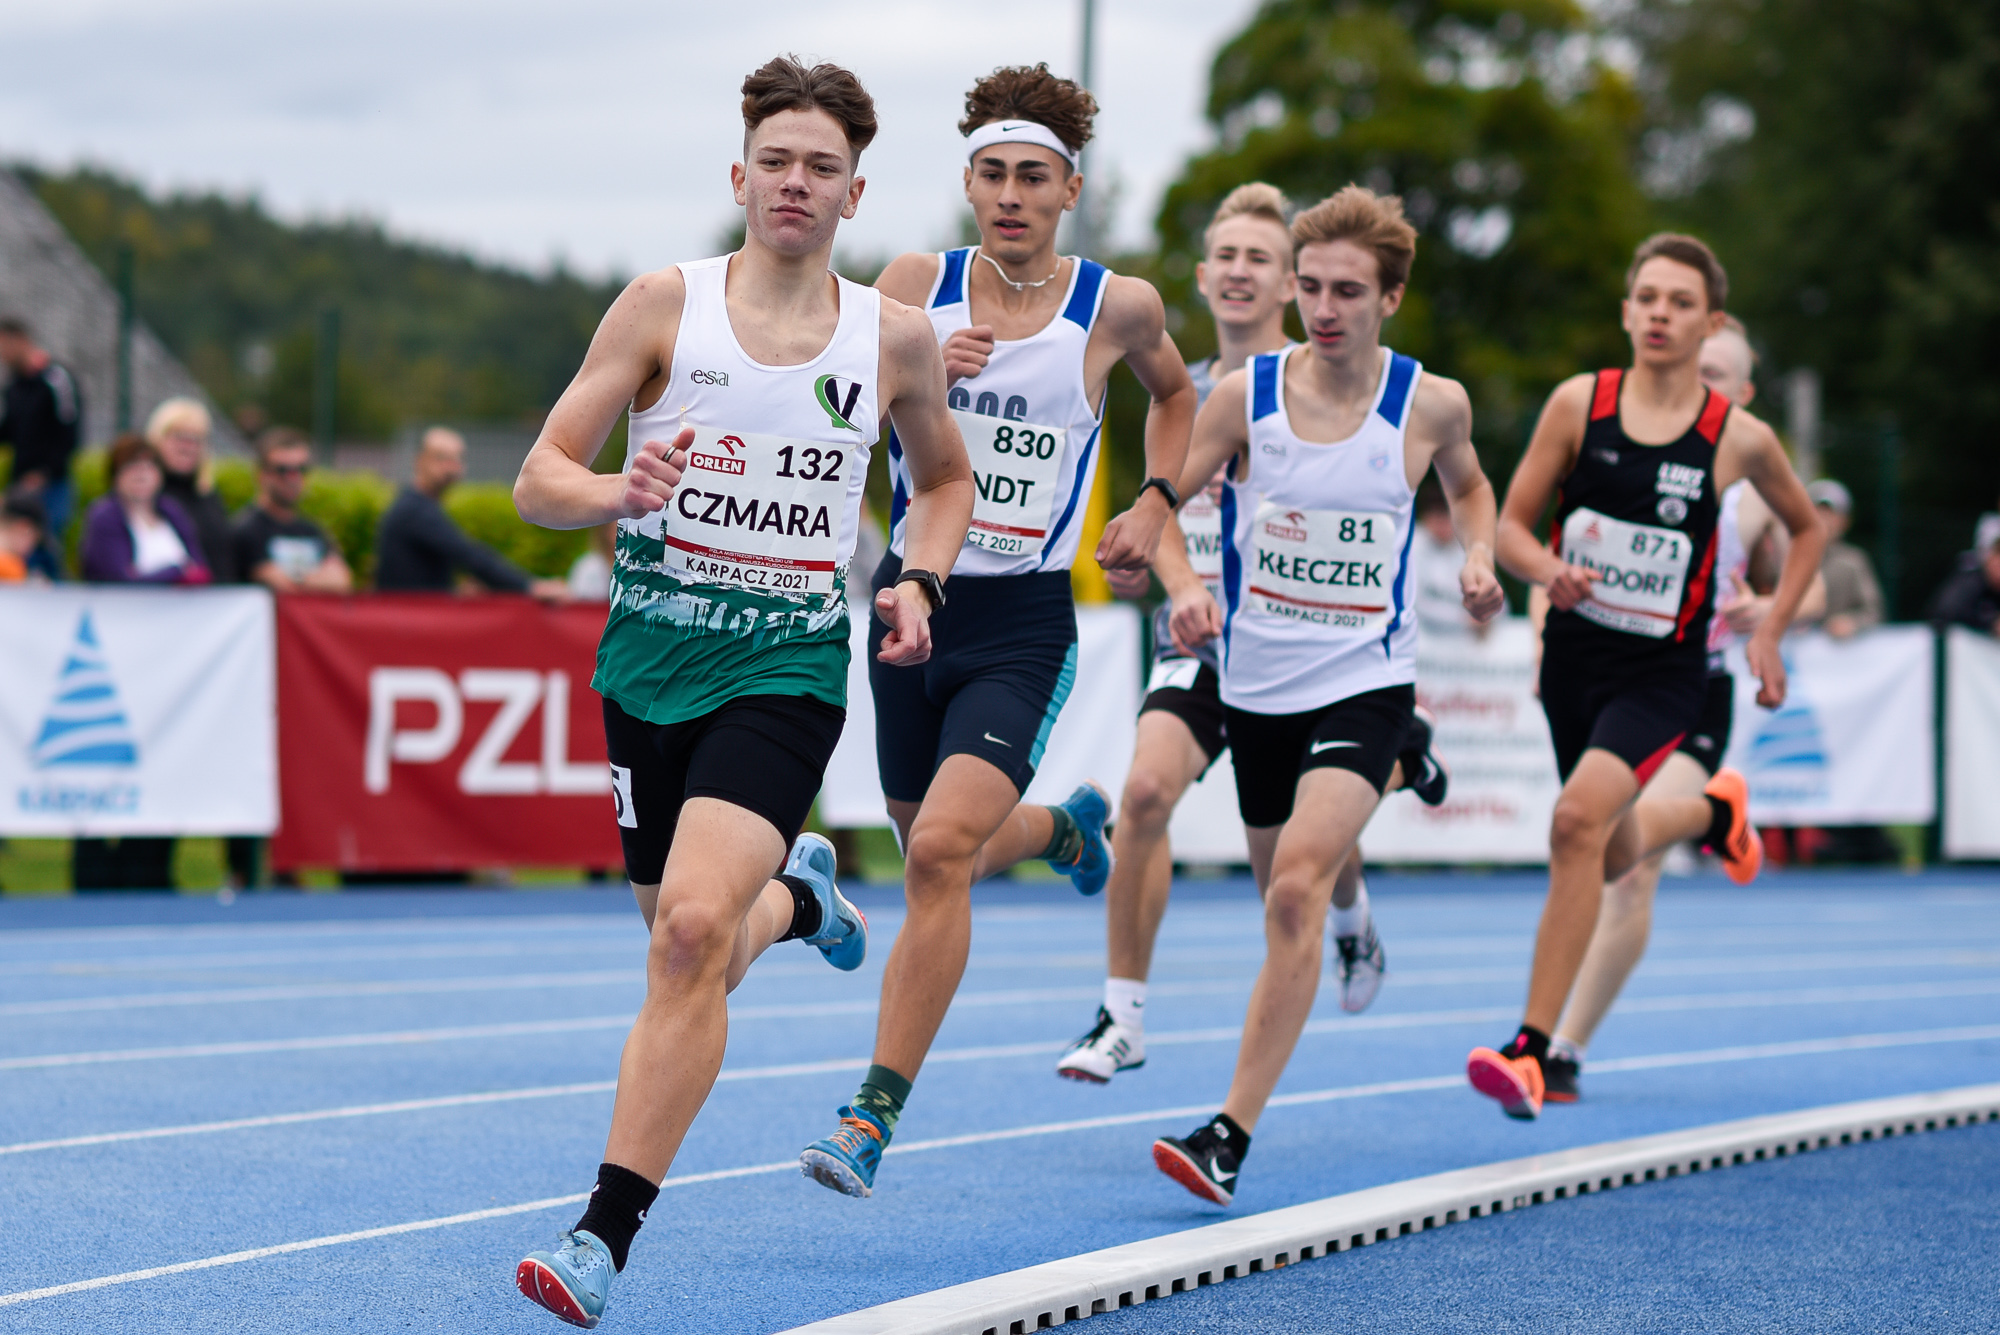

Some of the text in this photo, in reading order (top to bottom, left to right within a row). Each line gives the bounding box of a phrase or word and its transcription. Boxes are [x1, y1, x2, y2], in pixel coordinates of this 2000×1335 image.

[993, 425, 1056, 460] 830
[692, 455, 743, 474] ORLEN
[776, 445, 844, 482] 132
[677, 487, 831, 538] CZMARA
[989, 536, 1023, 552] 2021
[1338, 517, 1376, 544] 81
[1630, 531, 1680, 561] 871
[685, 556, 810, 590] KARPACZ 2021
[1258, 548, 1383, 588] KŁECZEK
[1265, 601, 1330, 624] KARPACZ
[1333, 614, 1367, 627] 2021
[364, 666, 611, 796] PZL
